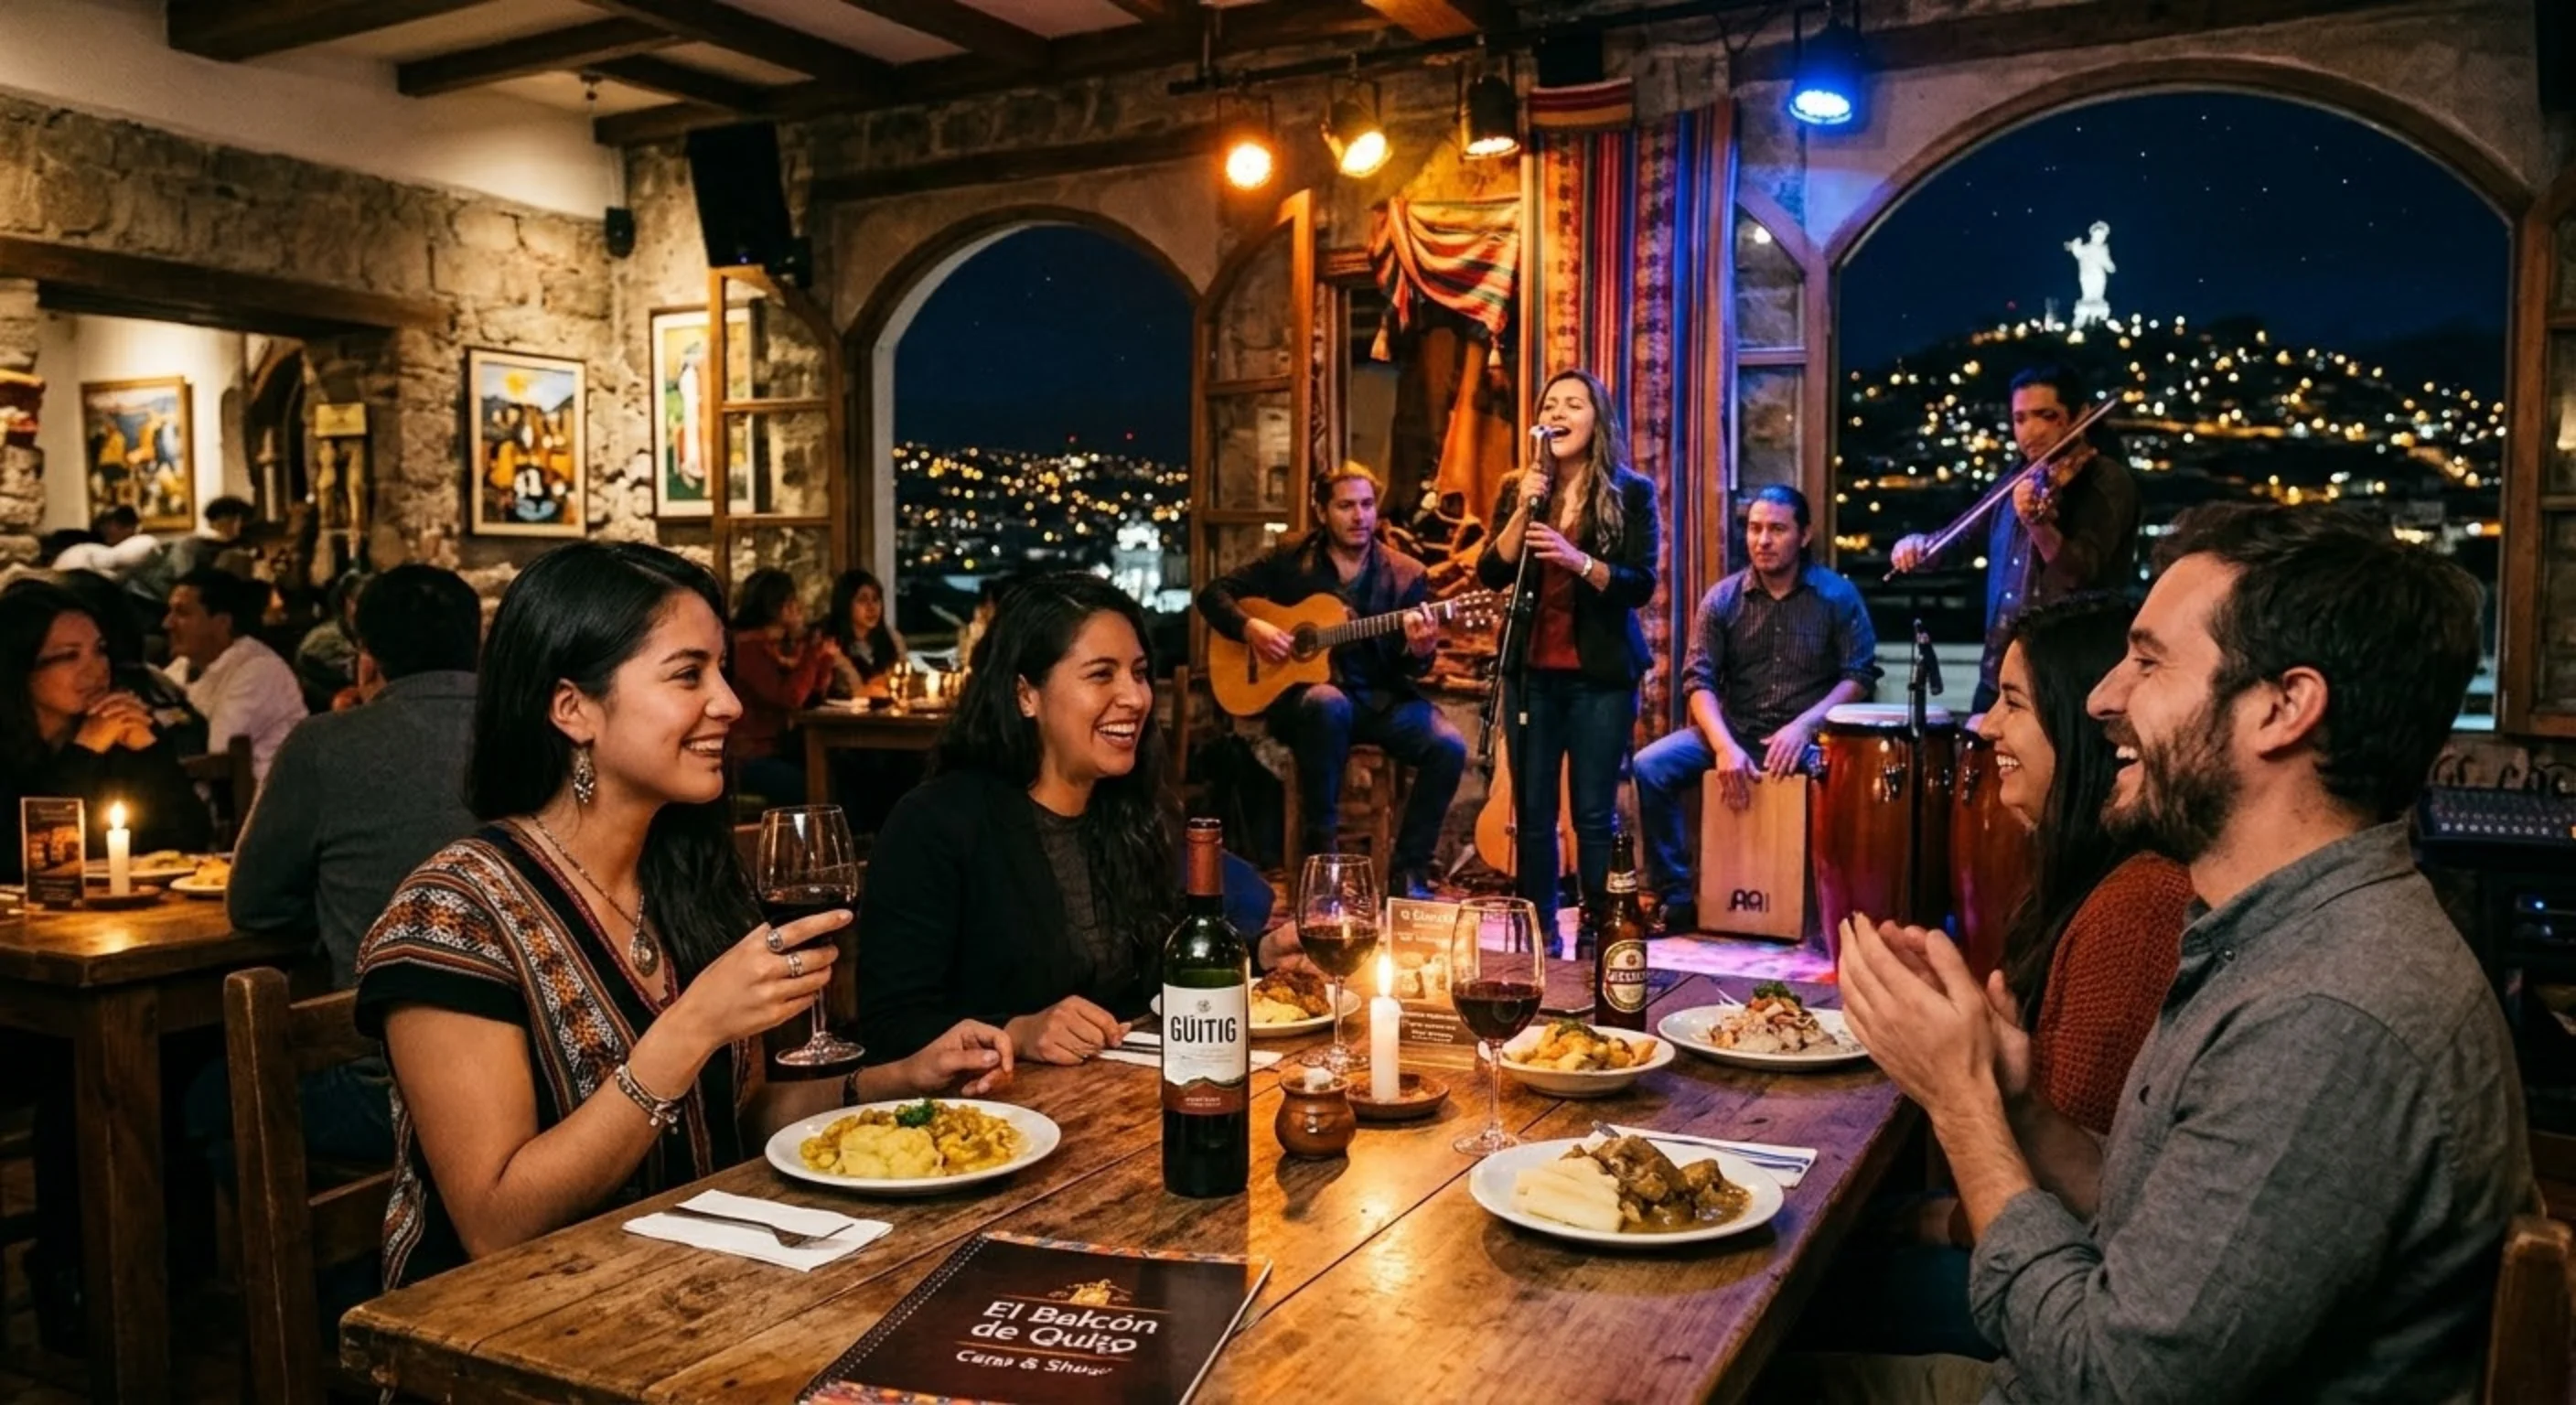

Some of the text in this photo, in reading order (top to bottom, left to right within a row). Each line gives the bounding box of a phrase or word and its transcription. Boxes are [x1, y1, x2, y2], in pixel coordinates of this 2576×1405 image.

[1170, 1014, 1237, 1044] GÜITIG
[971, 1320, 1019, 1340] de
[982, 1301, 1158, 1335] El Balcón
